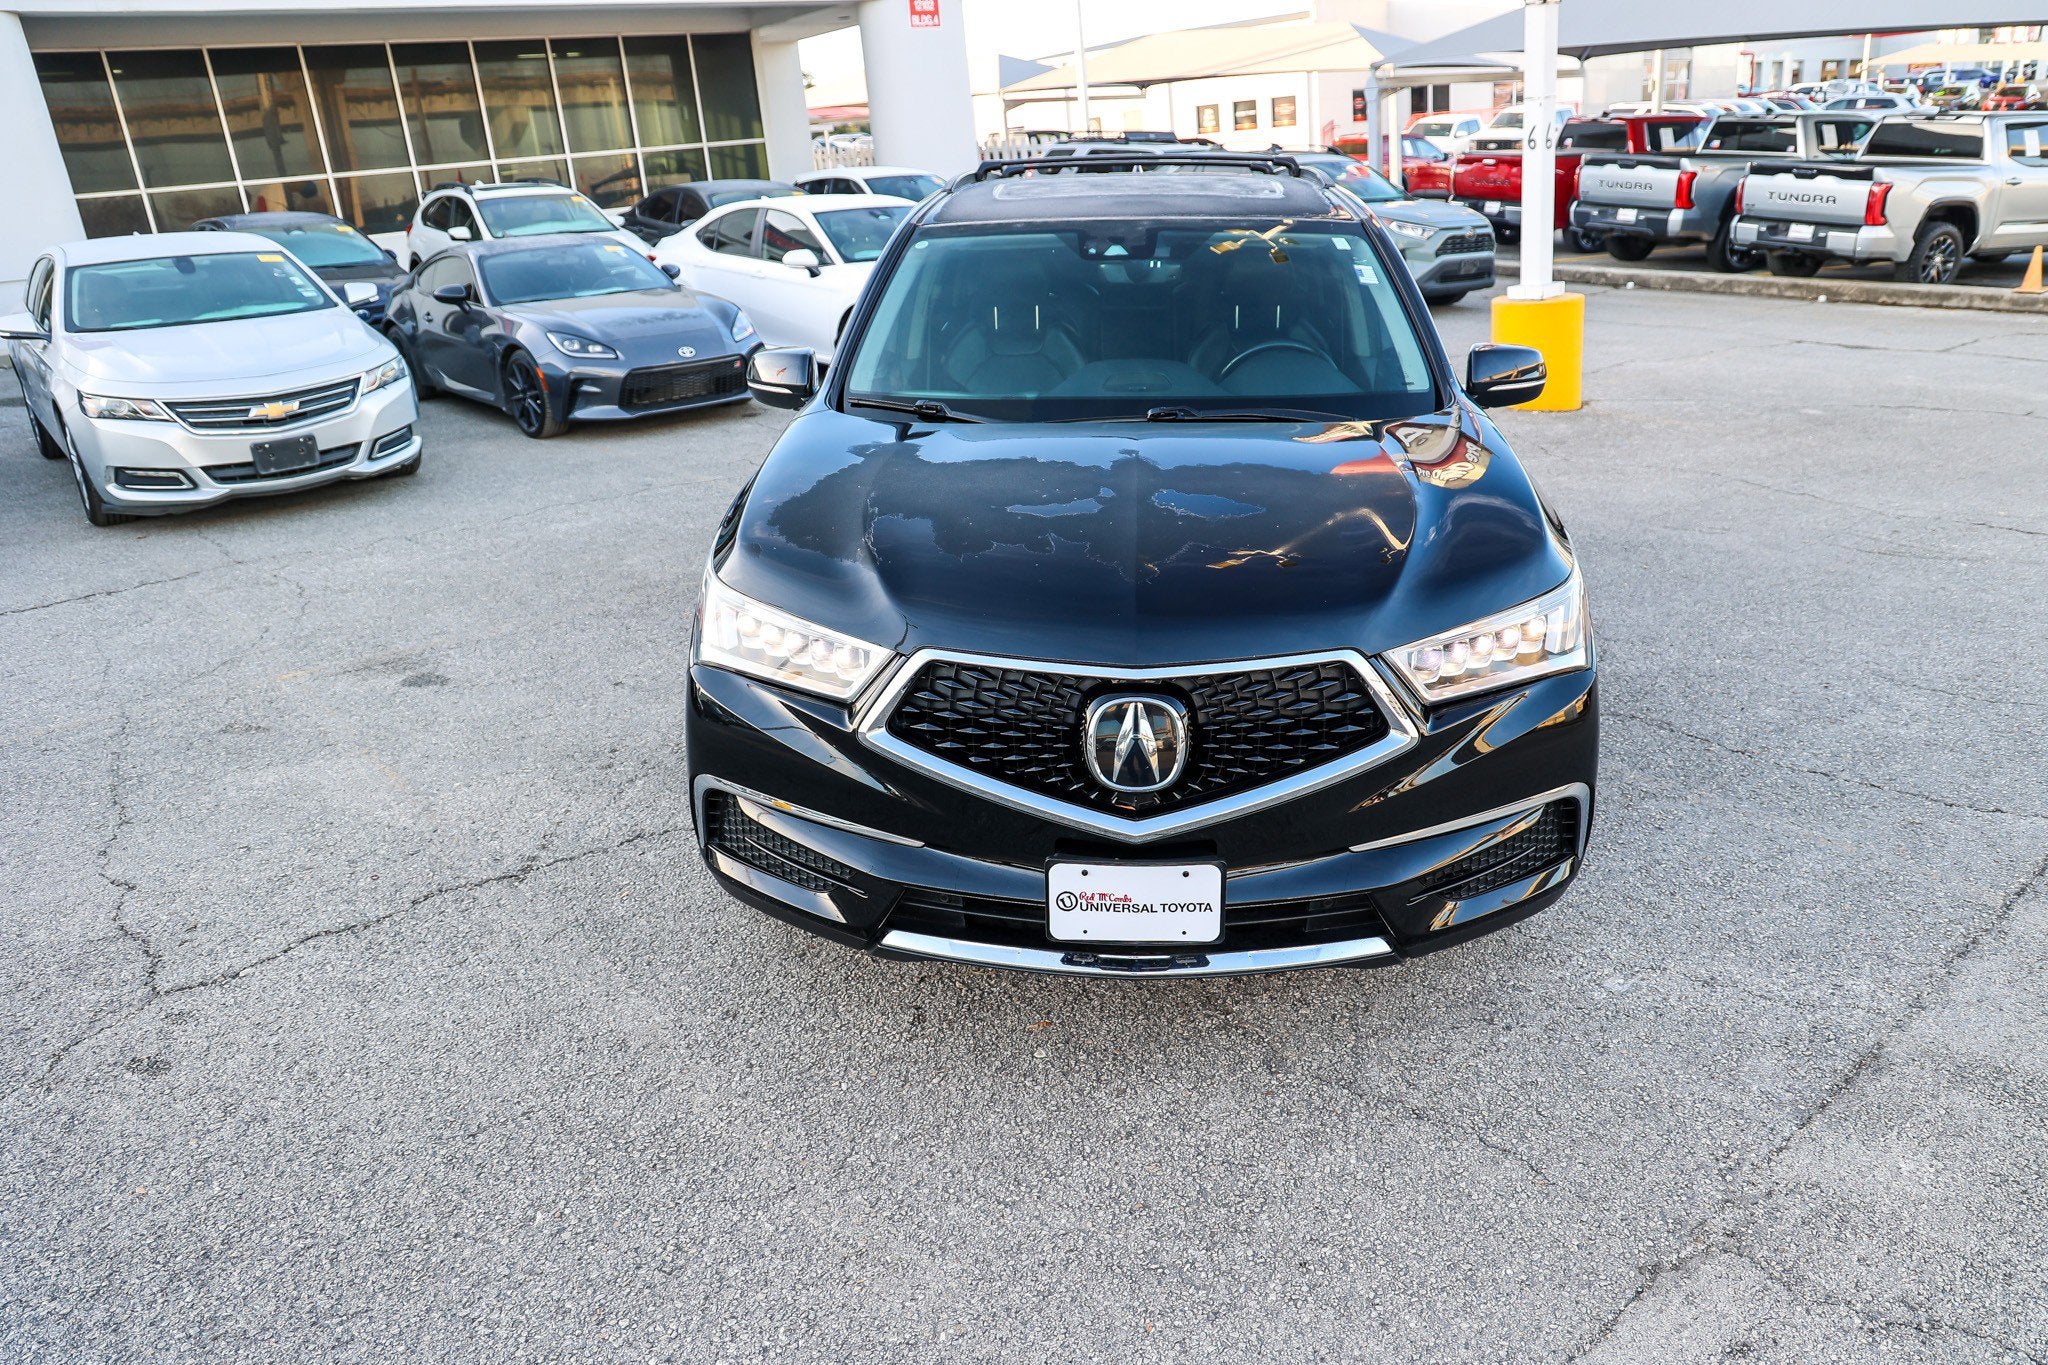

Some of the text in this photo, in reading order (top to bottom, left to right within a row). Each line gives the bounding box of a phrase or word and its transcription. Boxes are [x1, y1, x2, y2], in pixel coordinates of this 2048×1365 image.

[1599, 180, 1653, 191] TUNDRA
[1767, 190, 1837, 204] TUNDRA
[1080, 902, 1213, 914] UNIVERSAL TOYOTA
